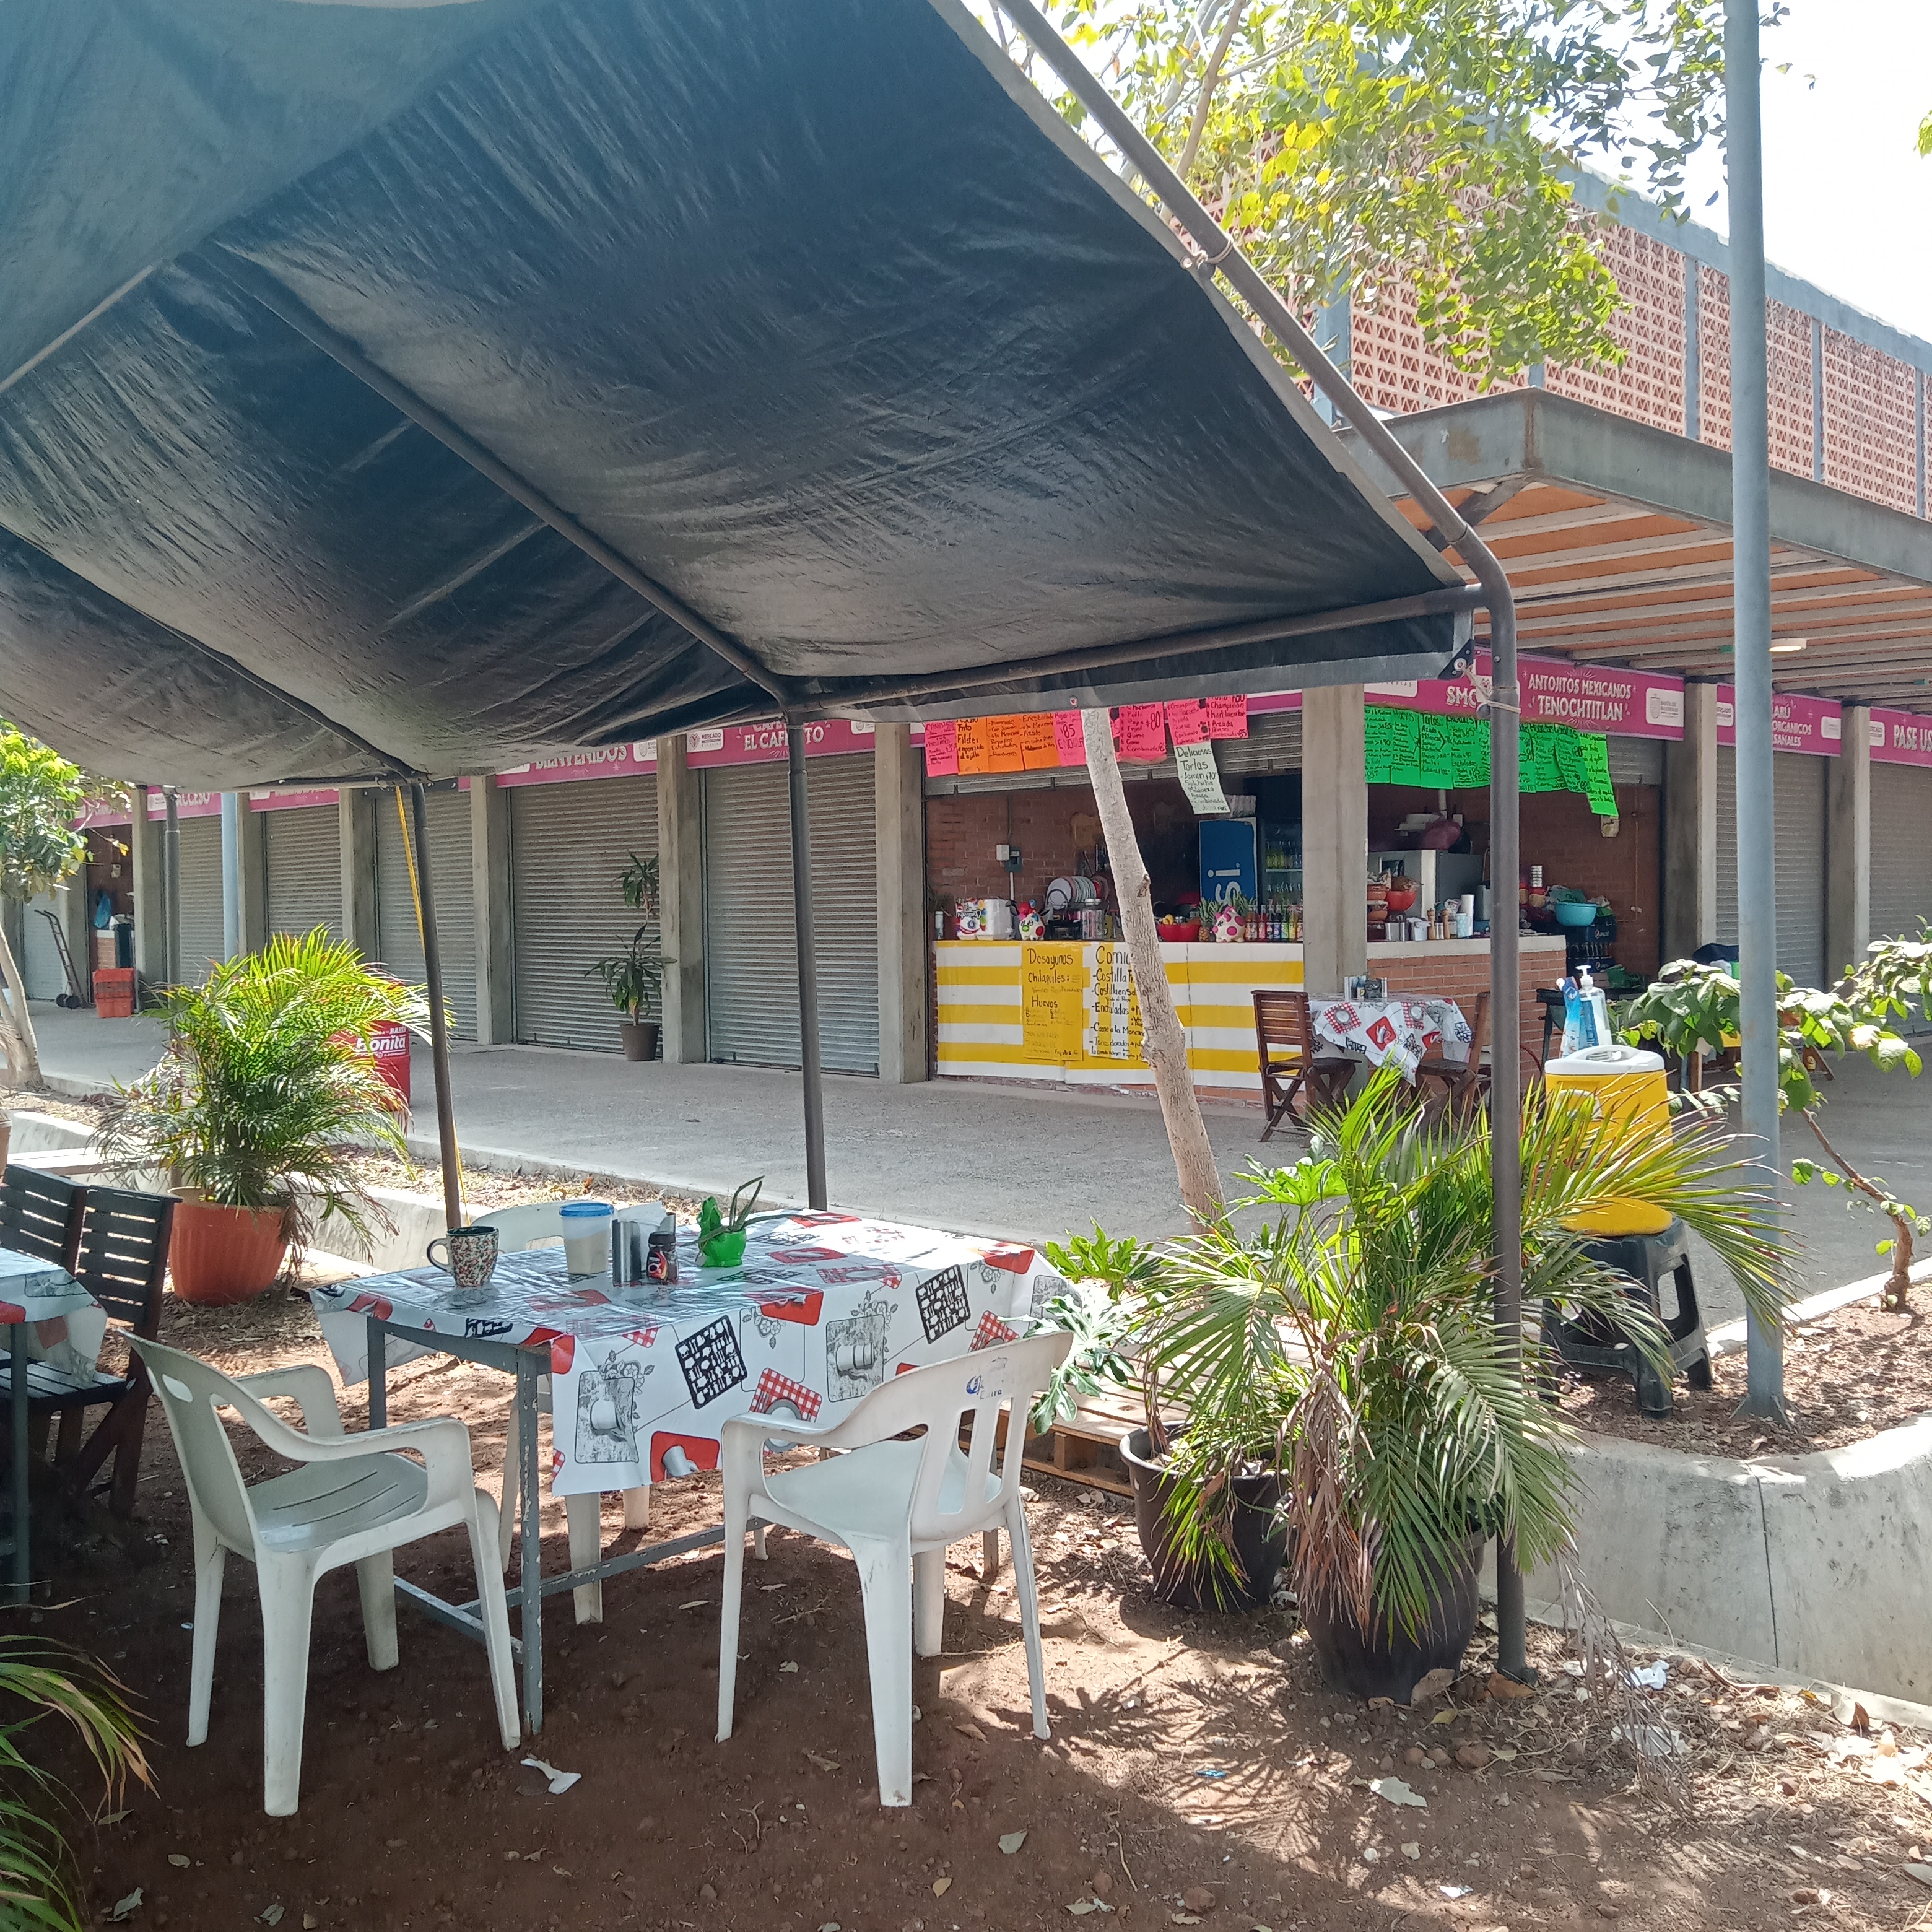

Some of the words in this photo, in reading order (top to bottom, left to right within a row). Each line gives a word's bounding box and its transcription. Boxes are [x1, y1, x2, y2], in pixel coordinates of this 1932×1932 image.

[1528, 673, 1580, 694] ANTOJITOS
[1582, 679, 1632, 700] MEXICANOS
[1537, 694, 1624, 721] TENOCHTITLAN
[744, 734, 758, 751] EL
[1893, 724, 1917, 751] PASE
[1180, 758, 1209, 772] Tortas
[1031, 994, 1058, 1009] Huevos
